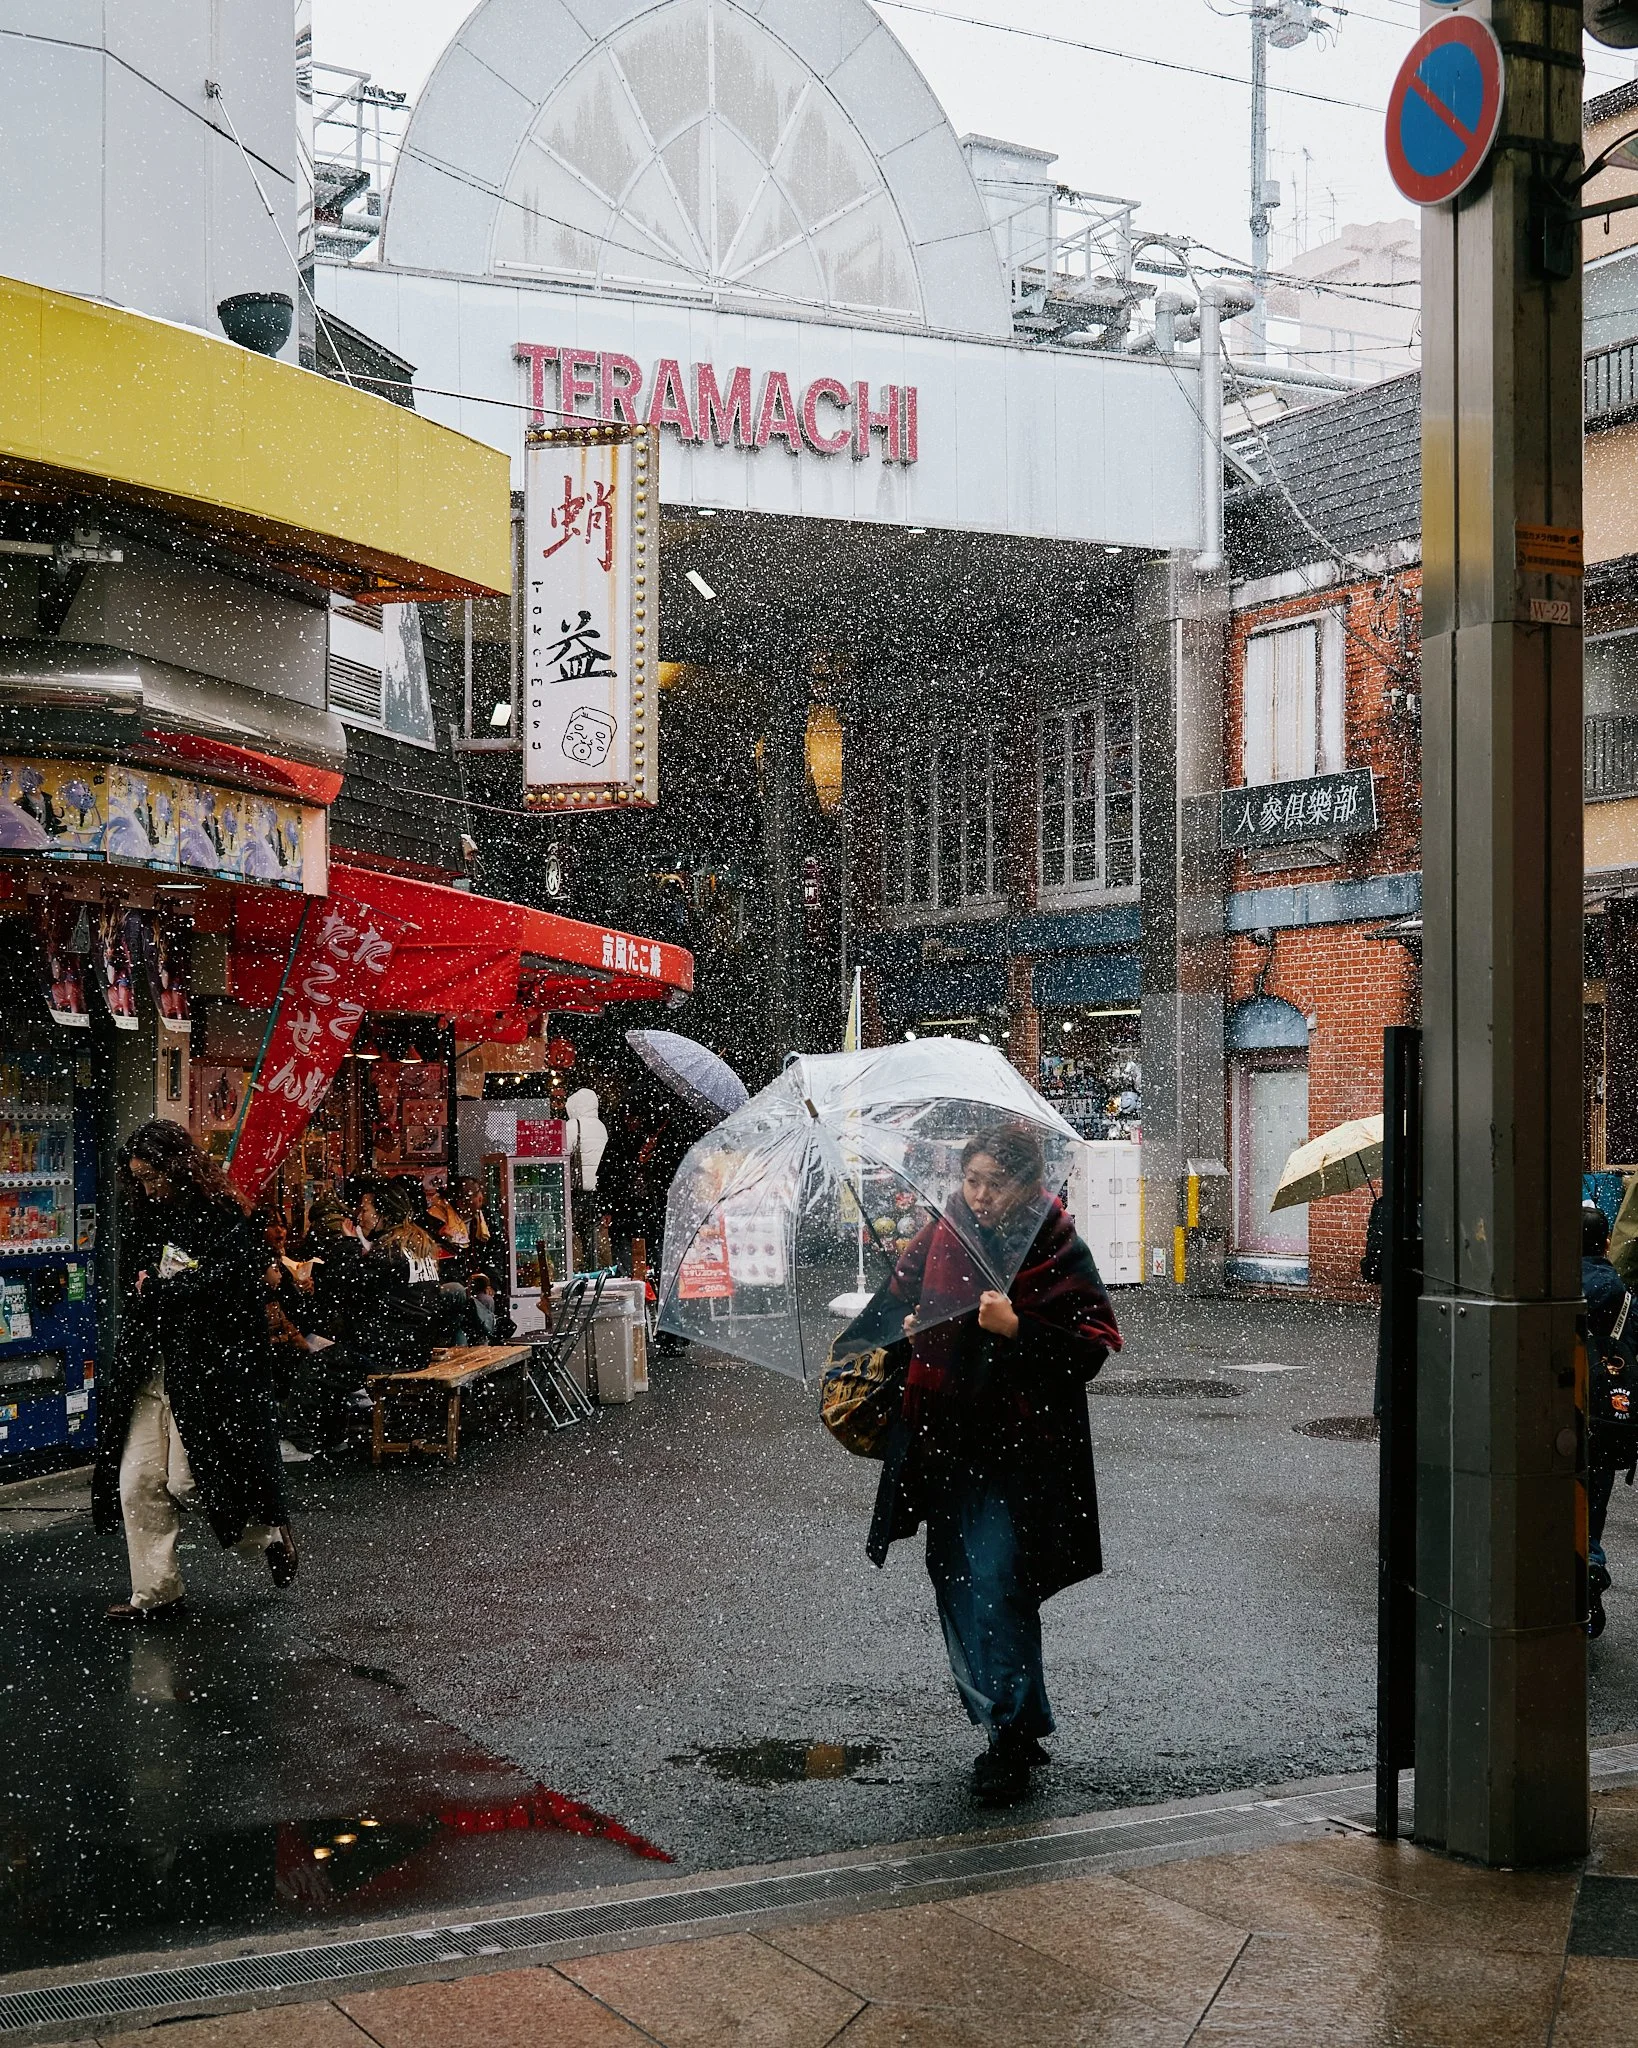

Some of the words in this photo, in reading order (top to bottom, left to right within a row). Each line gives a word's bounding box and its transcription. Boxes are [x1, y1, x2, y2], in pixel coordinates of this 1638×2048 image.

[512, 342, 918, 464] TERAMACHI
[542, 474, 618, 684] 蛸益
[1532, 601, 1569, 621] W-22
[267, 909, 356, 1104] たこせん
[601, 932, 662, 978] 京風たこ焼
